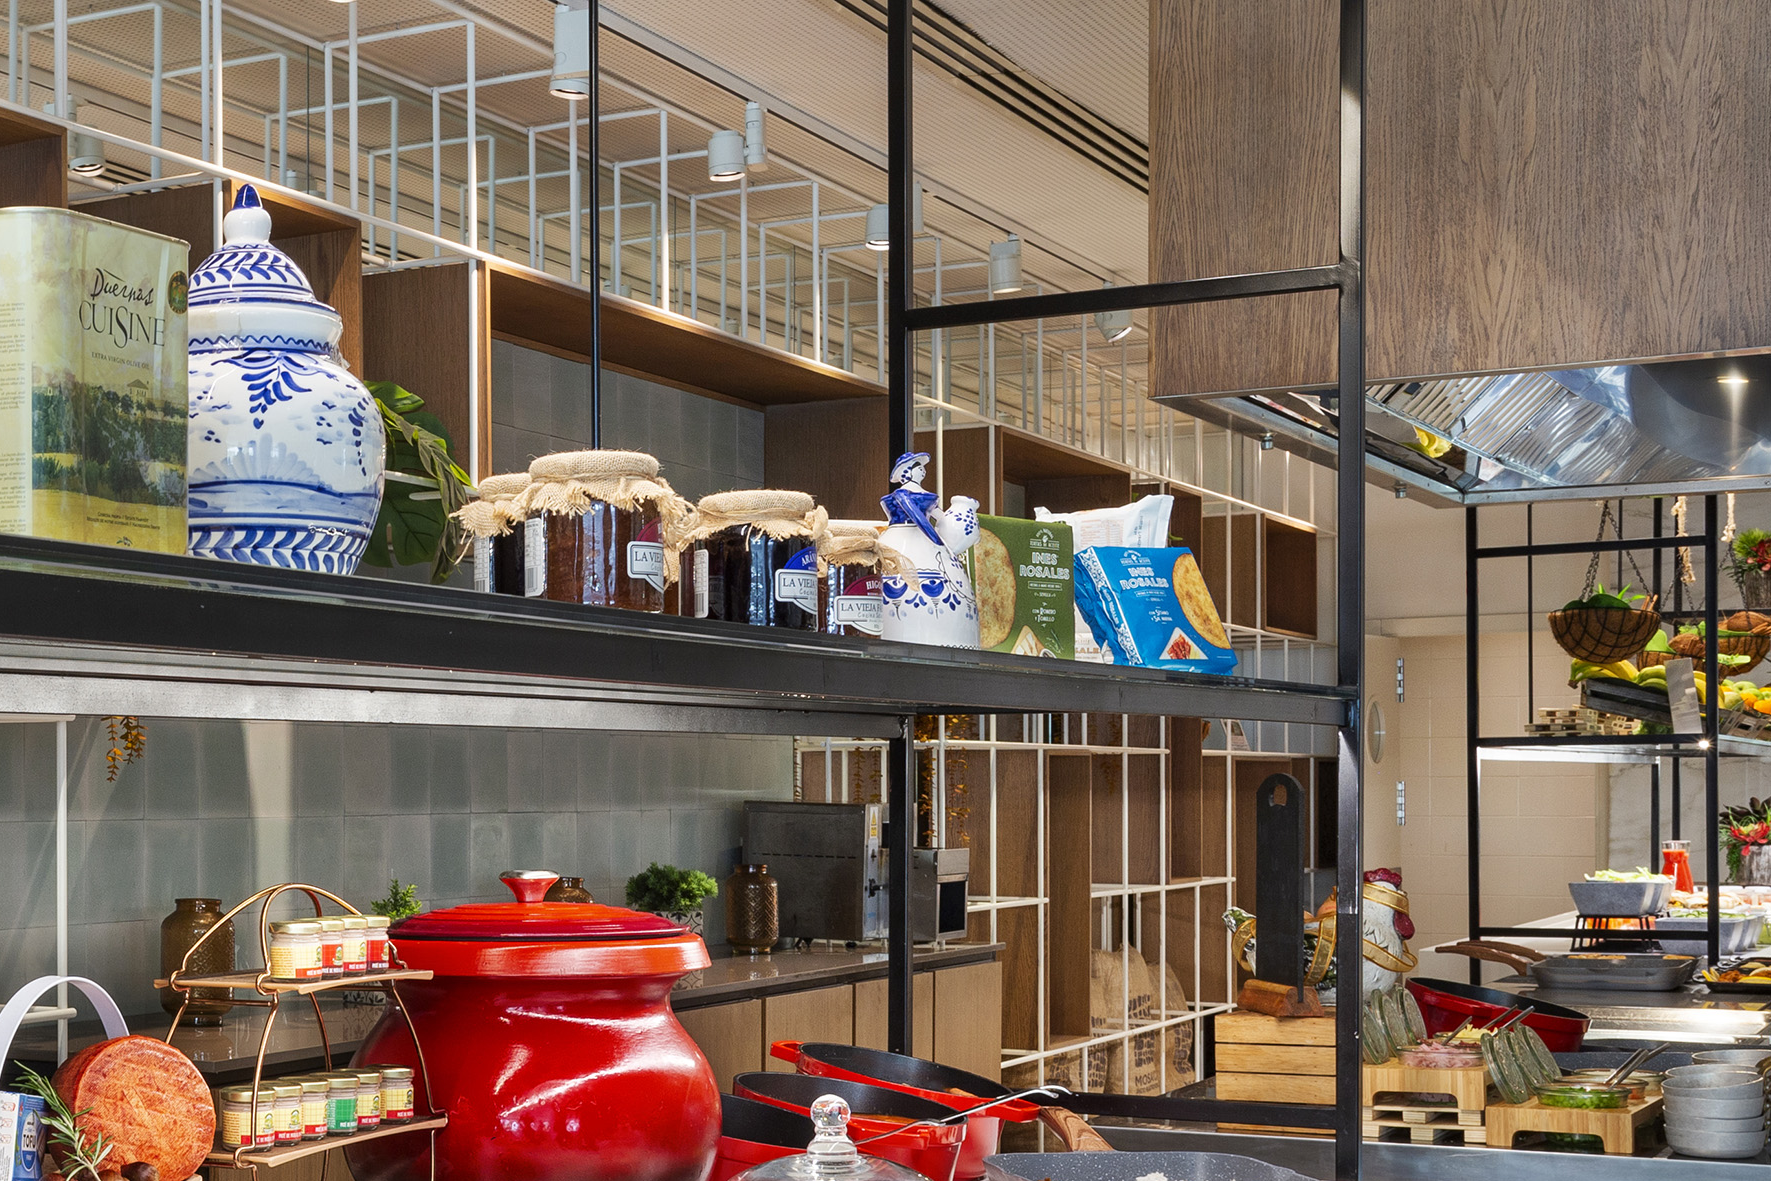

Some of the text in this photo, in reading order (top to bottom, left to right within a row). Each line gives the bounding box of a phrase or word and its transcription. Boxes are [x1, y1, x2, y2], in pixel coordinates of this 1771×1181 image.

[78, 300, 166, 349] CUISINE
[91, 352, 107, 361] EXTRA
[108, 356, 126, 364] VIRGIN
[634, 551, 664, 563] LA VIE
[1031, 551, 1058, 565] INES
[1019, 564, 1070, 580] ROSALES
[782, 578, 796, 587] LA
[1119, 577, 1169, 590] ROSALES
[841, 603, 854, 612] LA
